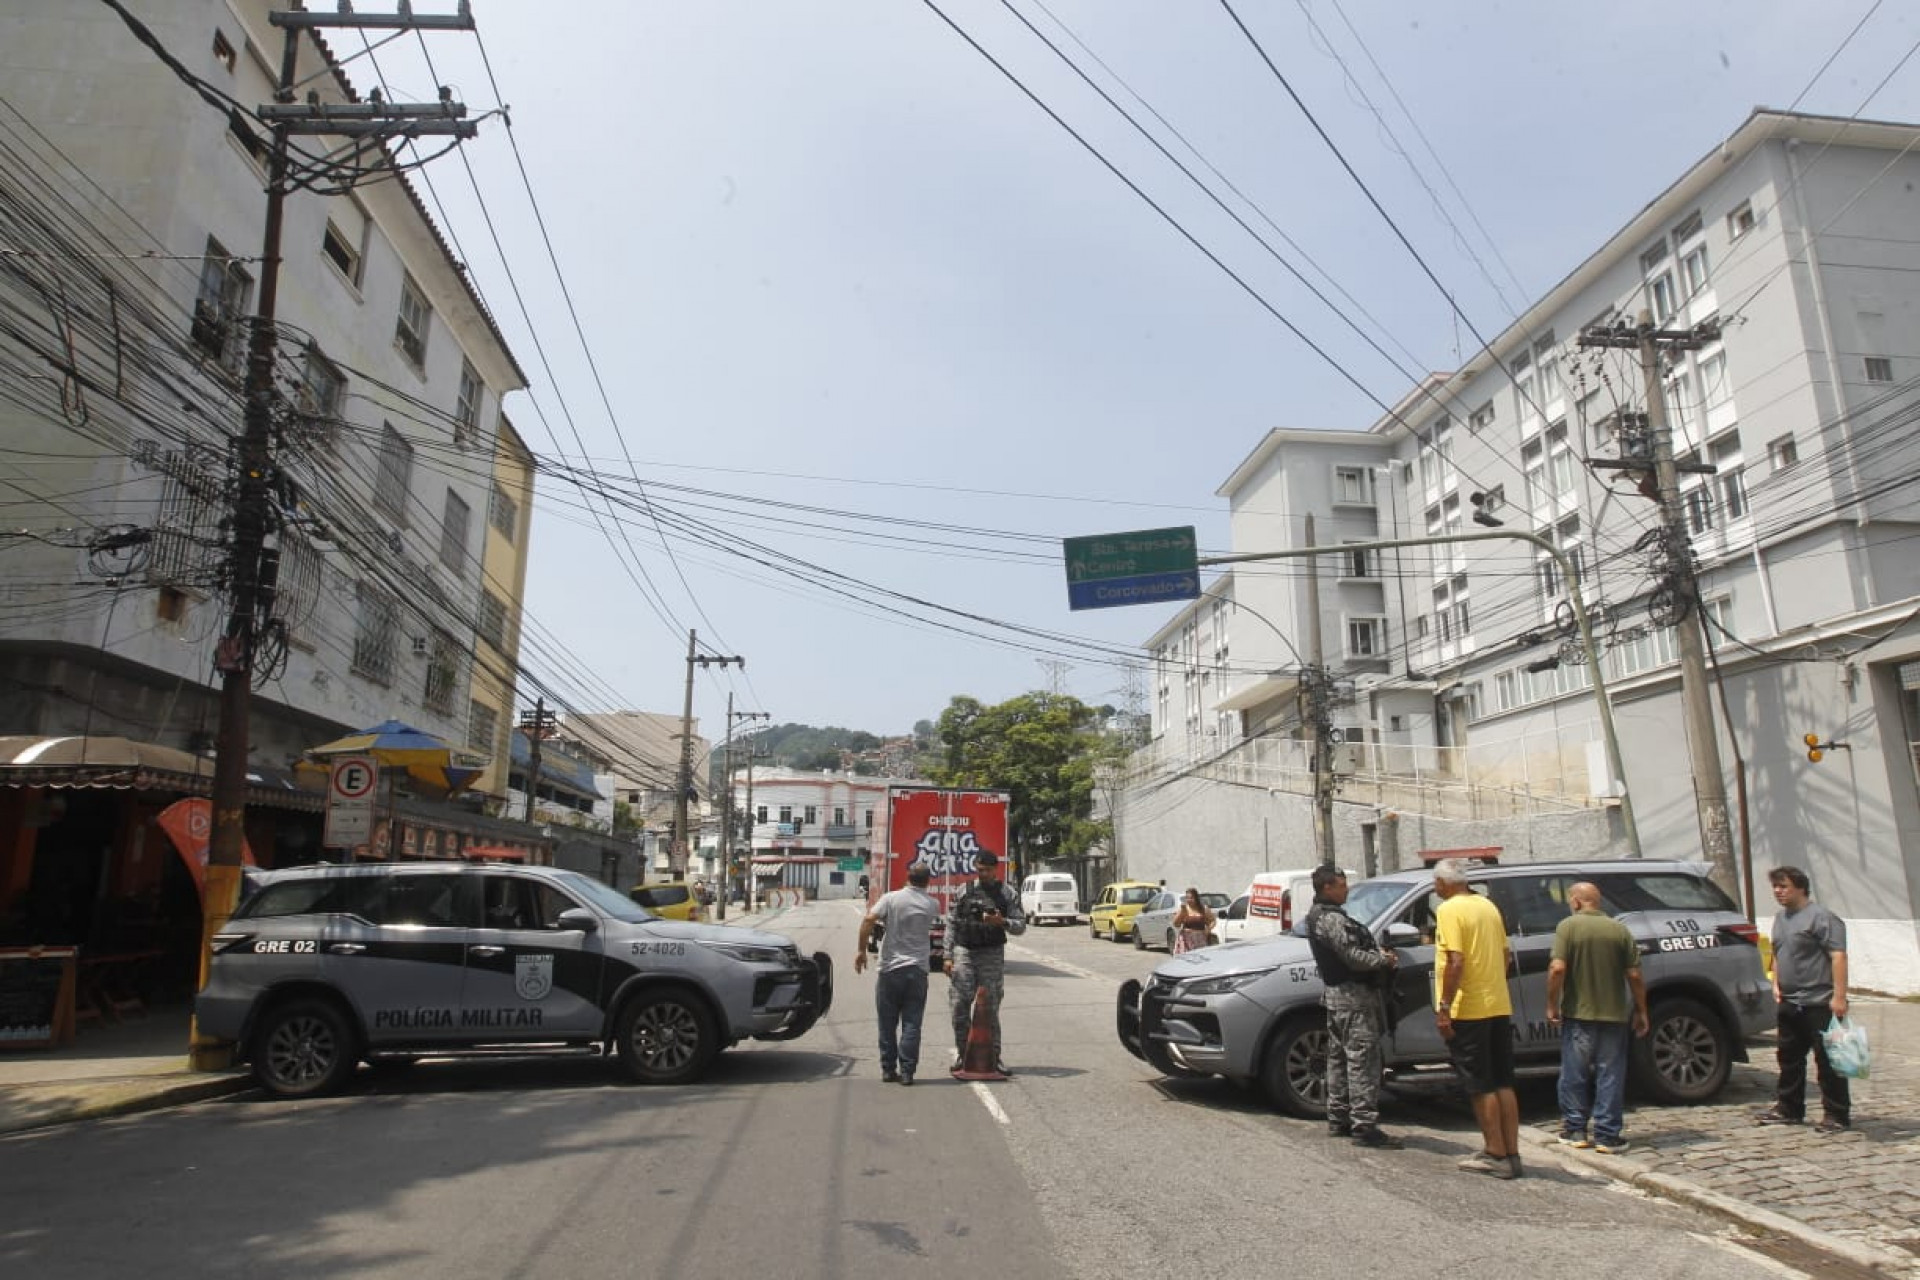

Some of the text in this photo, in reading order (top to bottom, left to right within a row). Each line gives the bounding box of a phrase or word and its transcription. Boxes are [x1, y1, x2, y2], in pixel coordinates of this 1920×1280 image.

[1097, 582, 1174, 599] Corcovado
[346, 768, 361, 789] E
[1666, 918, 1700, 933] 190
[254, 940, 315, 953] GRE 02
[631, 942, 685, 956] 52-4028
[1660, 934, 1714, 951] GRE 07
[376, 1006, 542, 1028] POLÍCIA MILITAR
